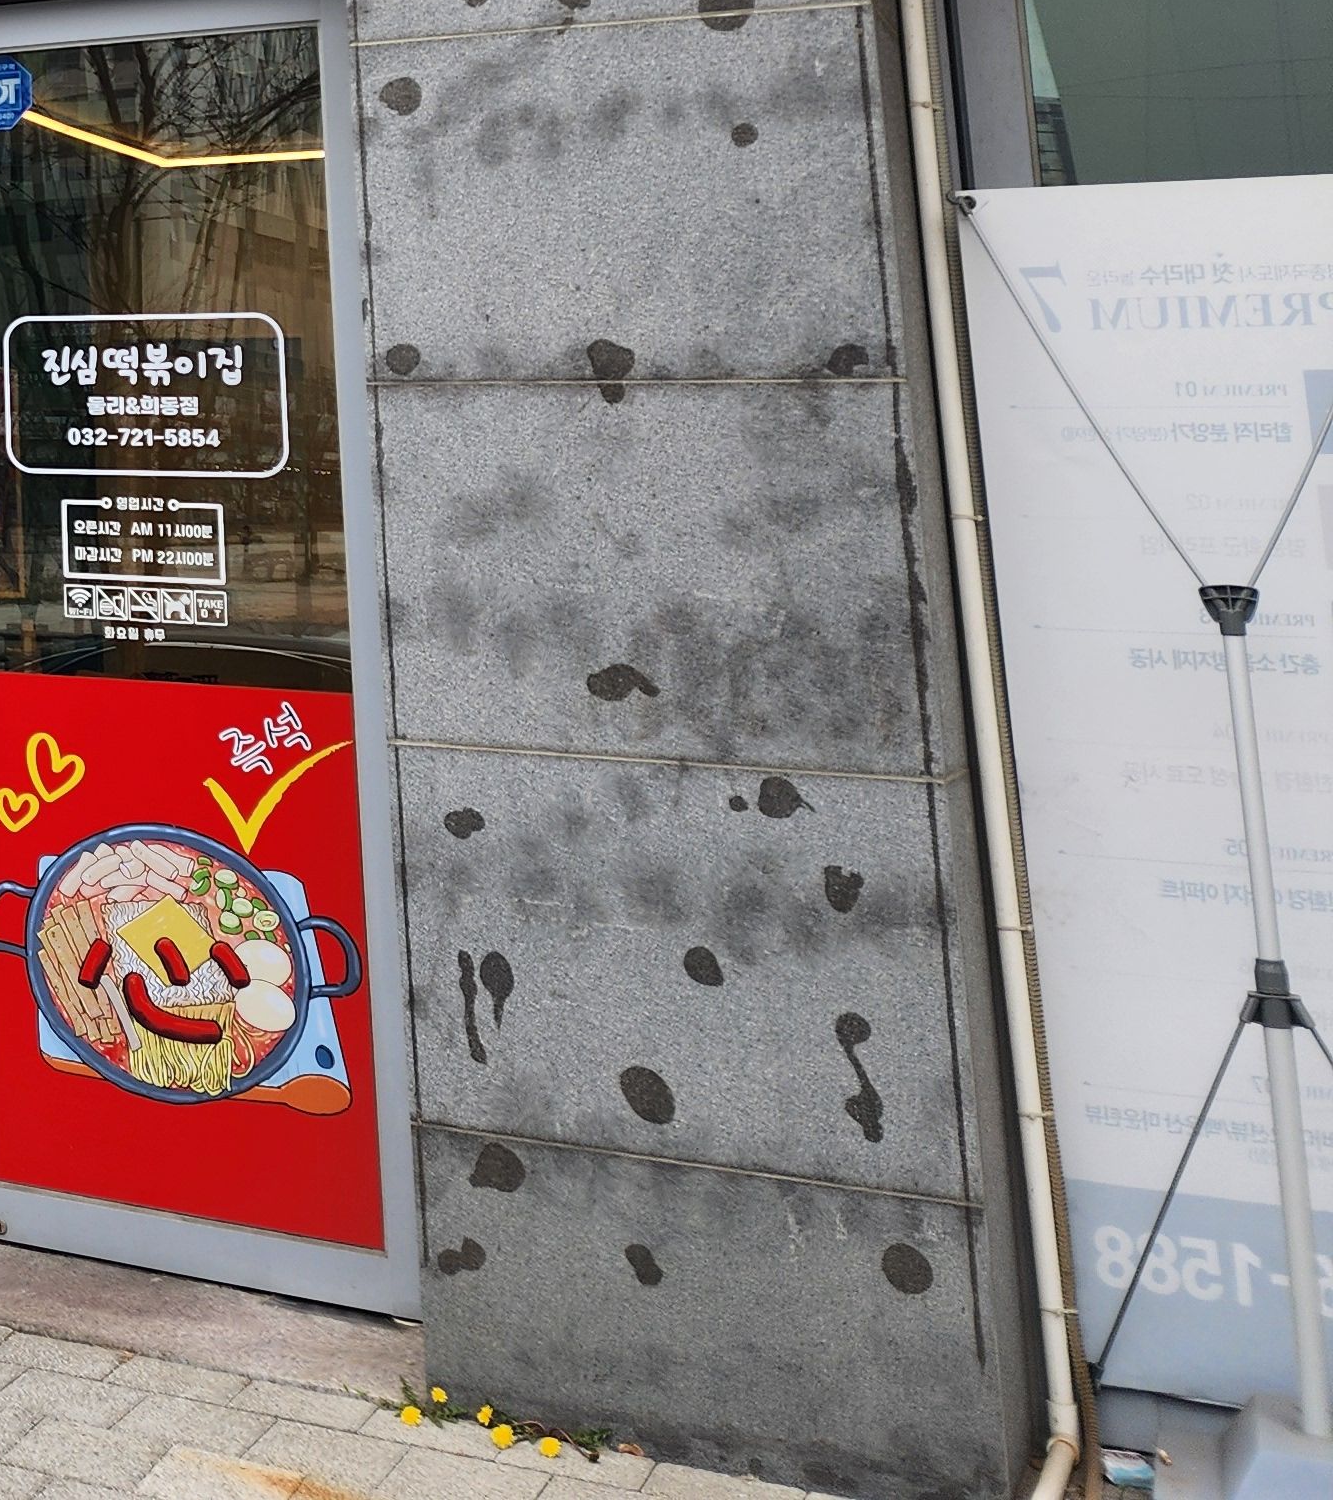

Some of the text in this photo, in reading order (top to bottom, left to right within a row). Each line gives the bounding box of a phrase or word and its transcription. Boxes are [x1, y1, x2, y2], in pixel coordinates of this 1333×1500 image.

[41, 344, 243, 386] 진심떡볶이집
[67, 428, 221, 448] 032-721-5854
[116, 497, 165, 512] 영업시간
[73, 520, 213, 539] 오픈시간 AM 11시00분
[74, 546, 214, 567] 마감시간 PM 22시00분
[196, 598, 224, 610] TAKE
[218, 702, 313, 776] 즉석
